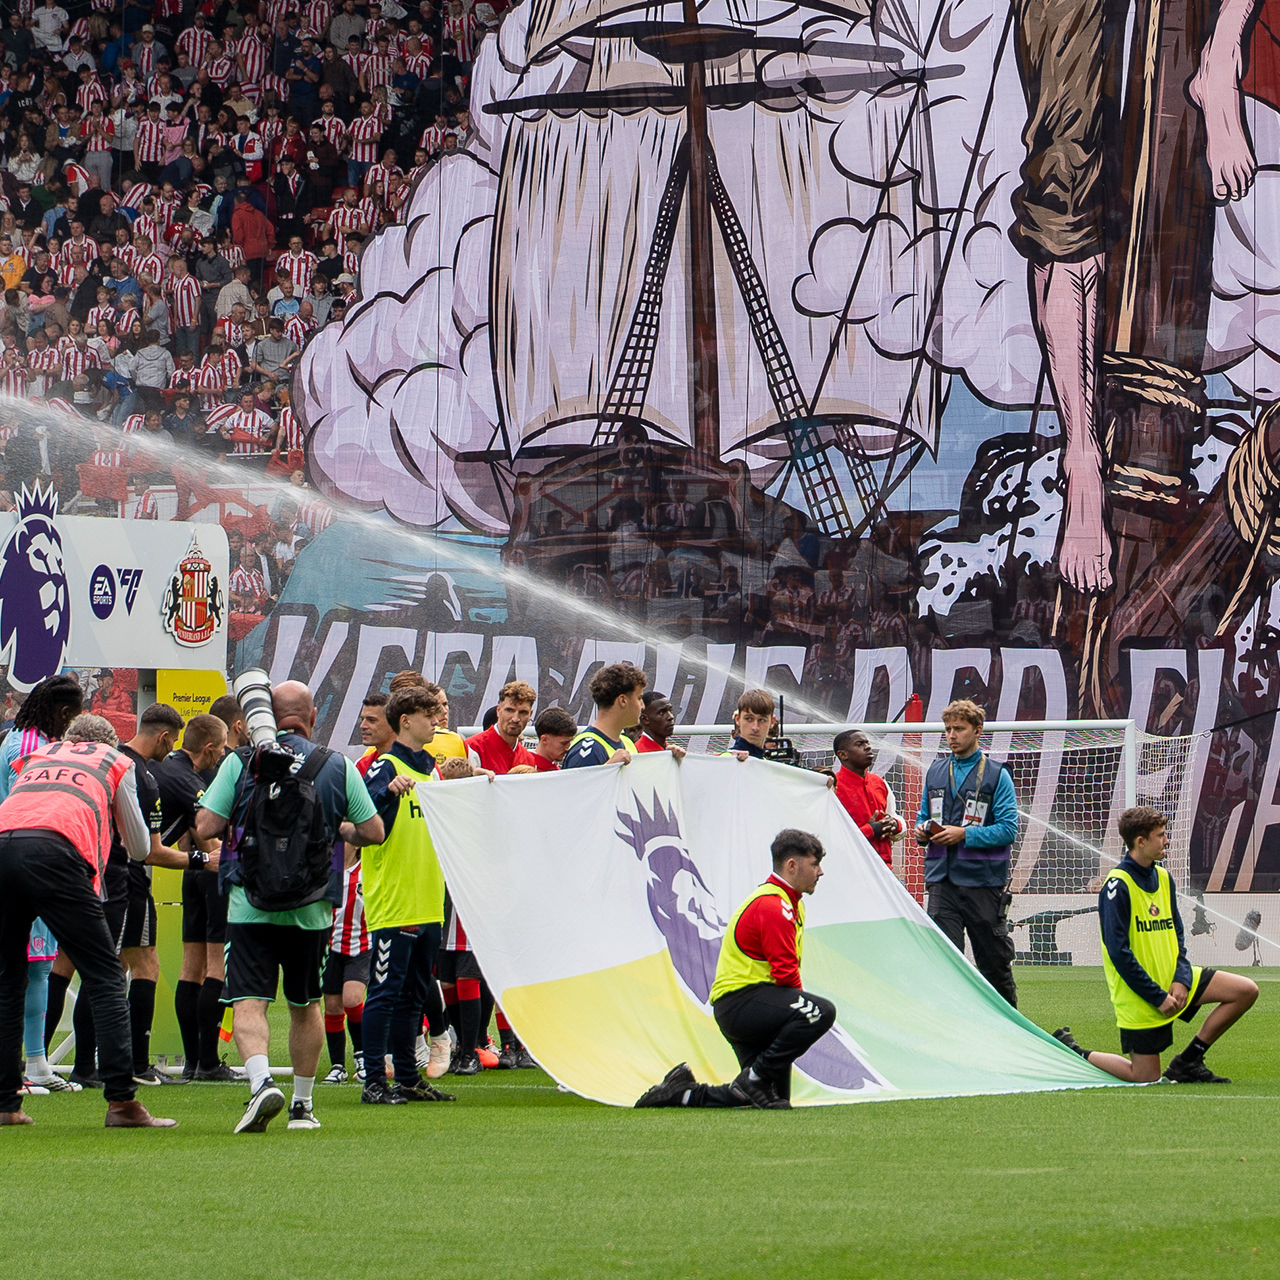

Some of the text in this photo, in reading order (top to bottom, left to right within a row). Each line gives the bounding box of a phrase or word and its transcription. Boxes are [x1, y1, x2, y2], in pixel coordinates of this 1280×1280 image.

[93, 576, 113, 595] EA
[92, 595, 113, 605] SPORTS
[173, 693, 211, 705] Premier League
[180, 708, 190, 717] Live
[23, 768, 88, 787] SAFC
[1135, 915, 1174, 932] humme
